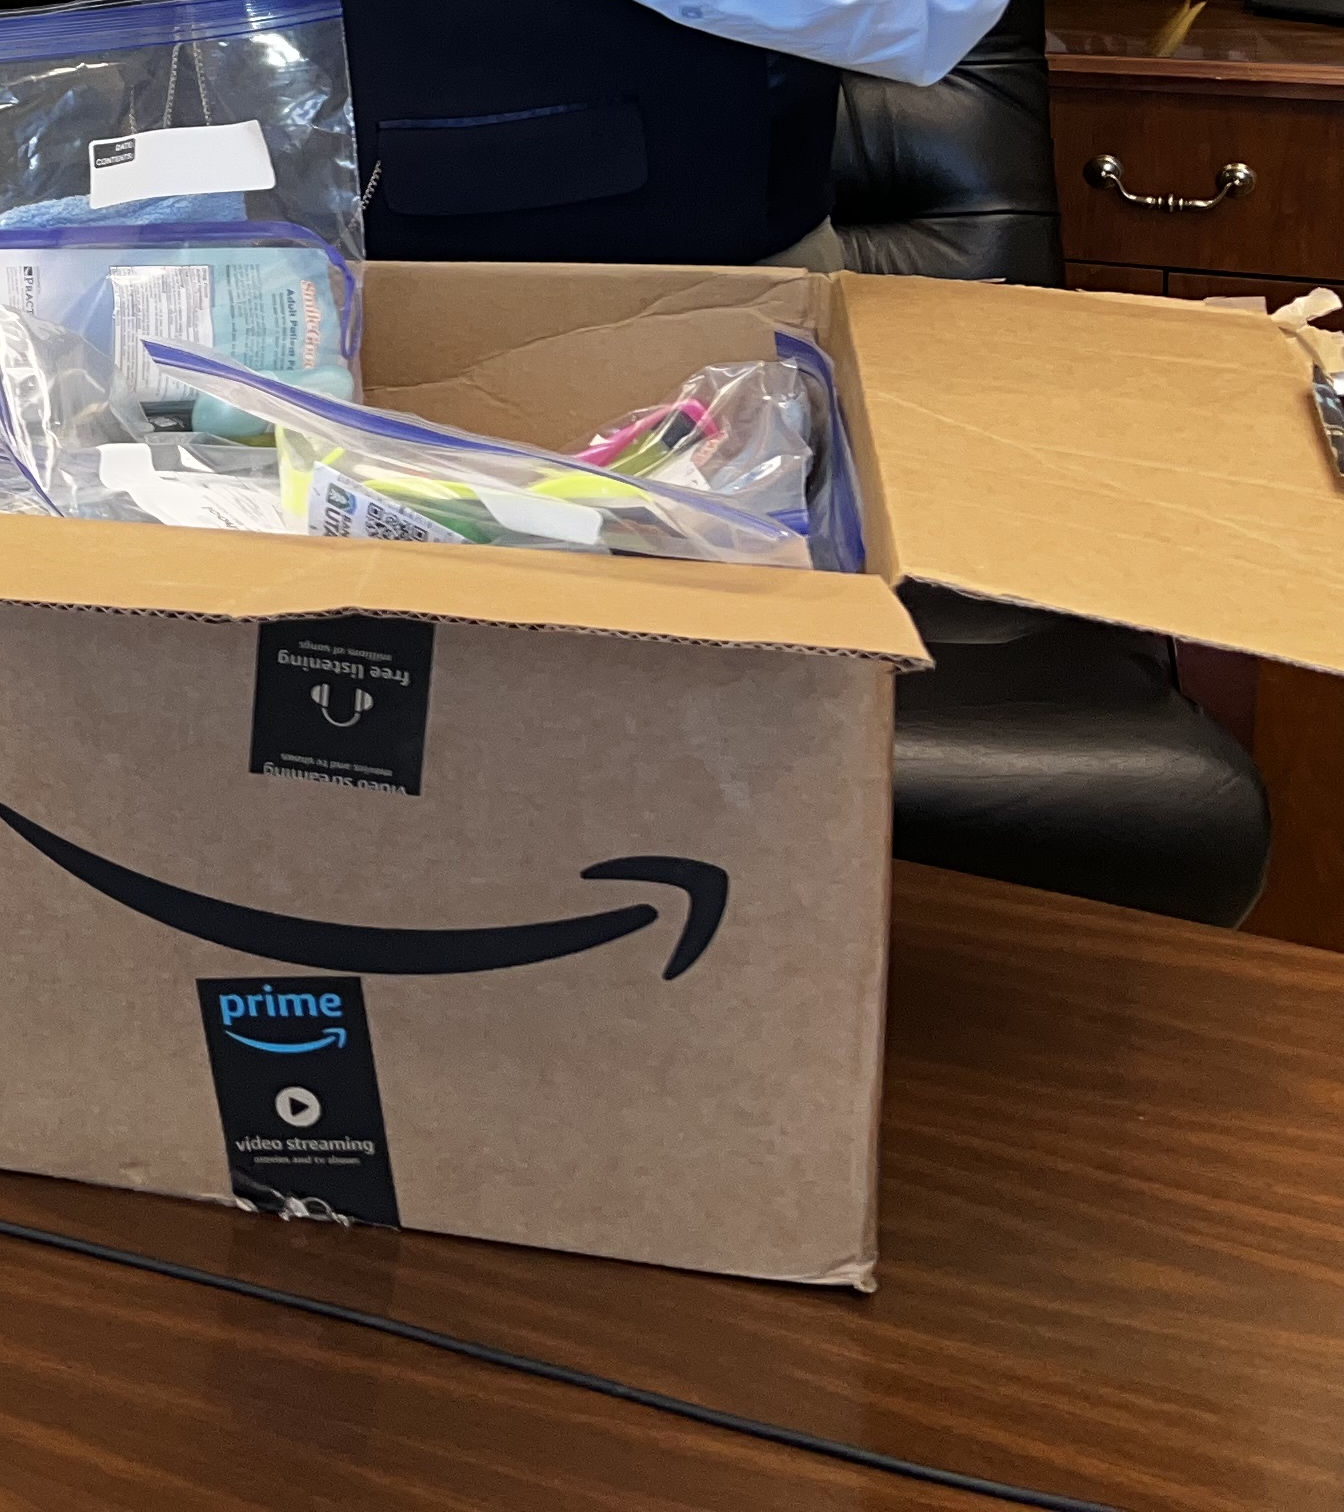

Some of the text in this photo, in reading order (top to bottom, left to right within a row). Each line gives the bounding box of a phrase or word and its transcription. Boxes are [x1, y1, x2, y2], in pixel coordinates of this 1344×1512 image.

[286, 288, 297, 316] Adult
[277, 650, 410, 686] free listening
[219, 984, 343, 1026] prime
[235, 1135, 375, 1154] video streaming
